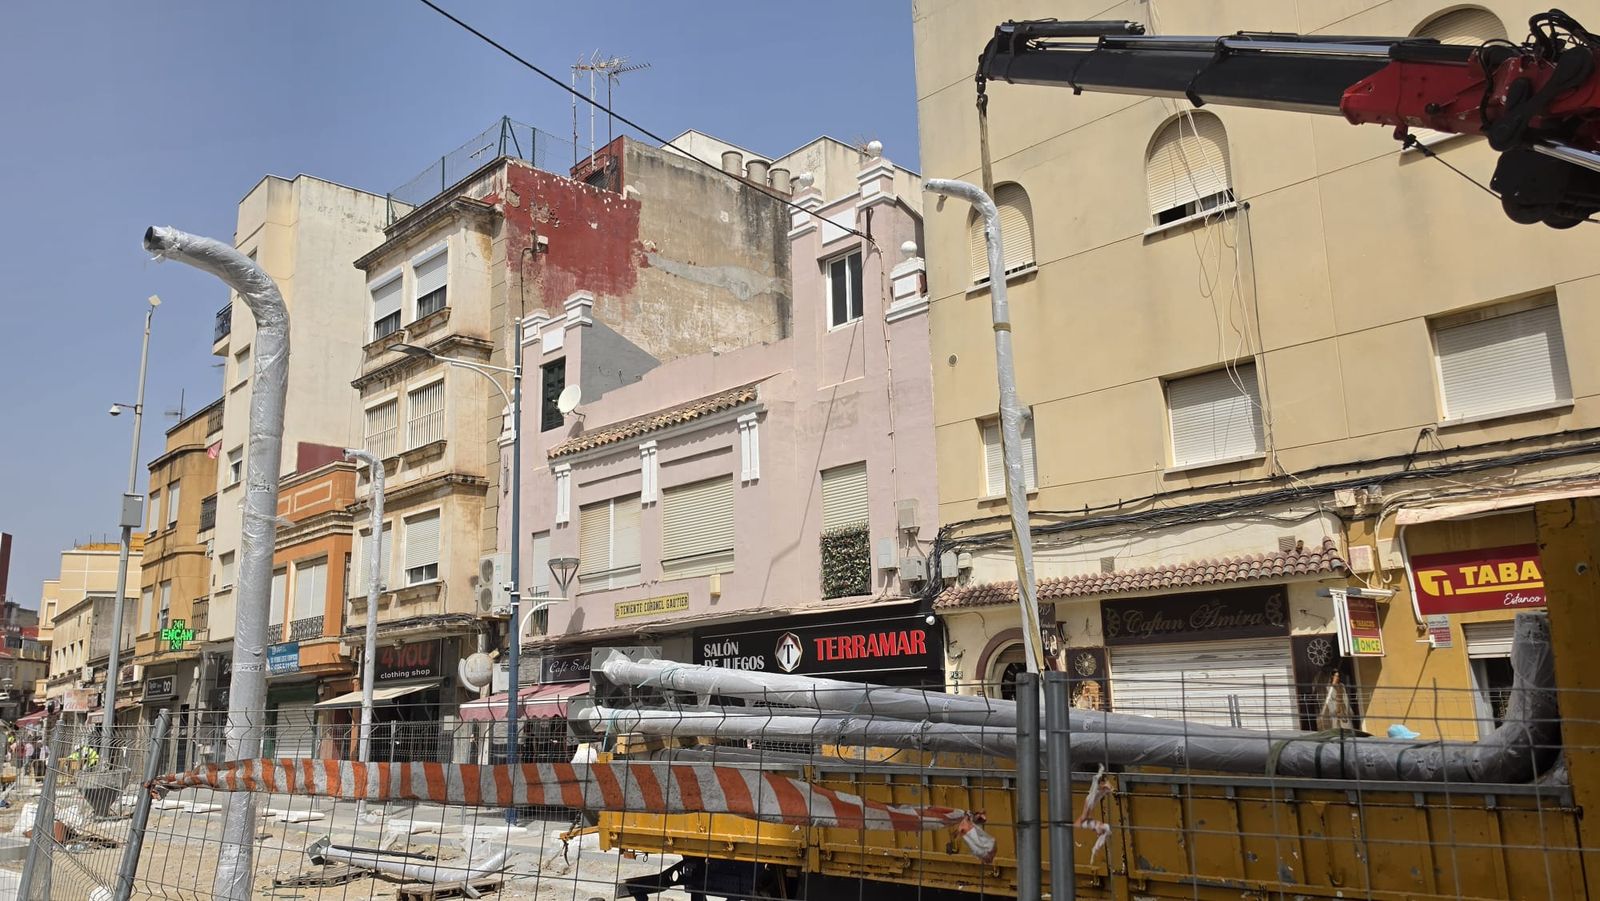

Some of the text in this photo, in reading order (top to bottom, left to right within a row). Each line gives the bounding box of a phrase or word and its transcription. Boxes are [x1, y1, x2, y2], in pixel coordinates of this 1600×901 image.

[620, 603, 643, 615] TENIENTE
[644, 599, 665, 612] CORONEL
[666, 596, 689, 609] GAUTIER
[1503, 592, 1542, 606] Estanco
[173, 619, 184, 629] 24H
[1122, 603, 1265, 639] Caftan Amira
[161, 629, 193, 640] ENCAN
[171, 640, 183, 650] 24H
[703, 638, 739, 658] SALÓN
[814, 629, 927, 662] TERRAMAR
[1360, 640, 1380, 652] ONCE
[381, 643, 432, 668] 4 YOU
[783, 643, 794, 665] T
[380, 668, 431, 679] clothing shop
[549, 660, 569, 677] Café
